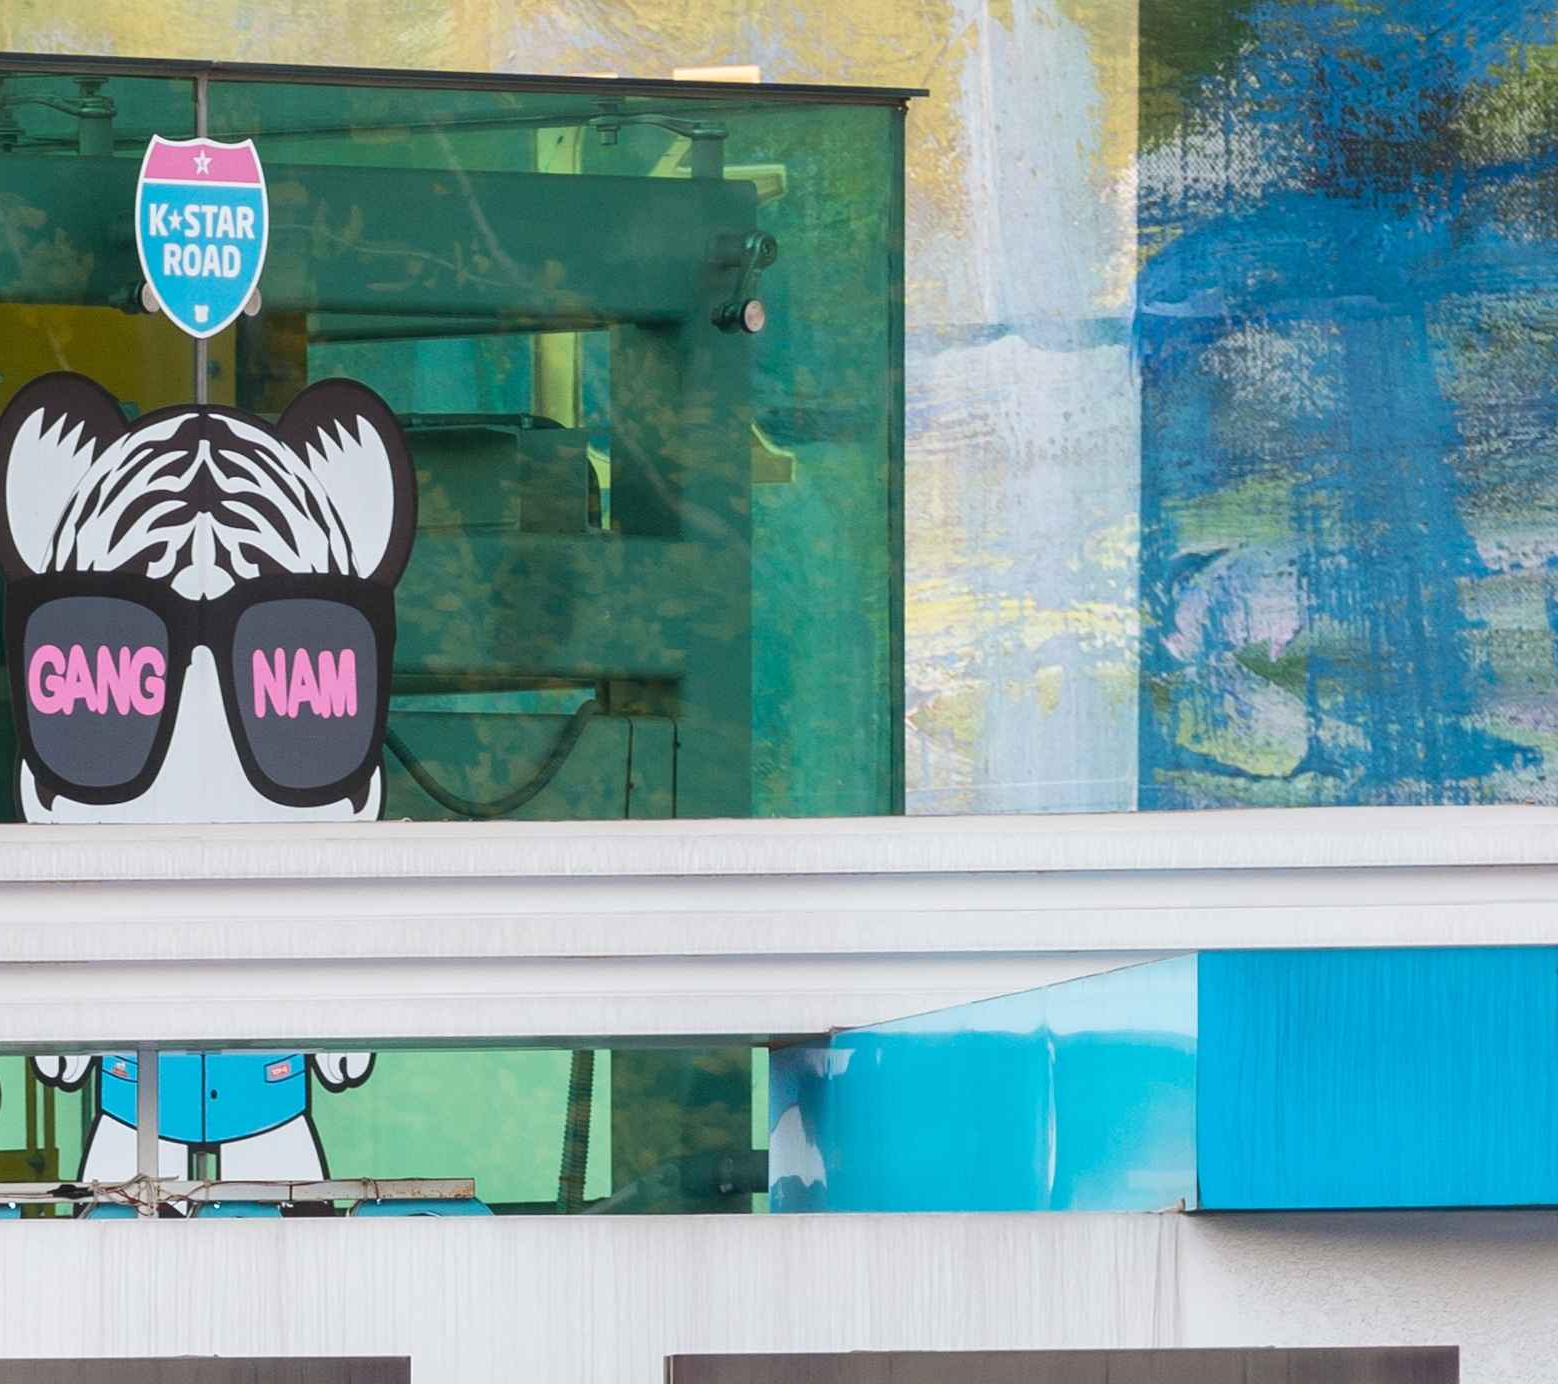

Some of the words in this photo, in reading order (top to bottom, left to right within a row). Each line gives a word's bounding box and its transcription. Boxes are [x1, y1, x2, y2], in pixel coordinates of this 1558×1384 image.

[163, 243, 242, 279] ROAD
[28, 644, 167, 716] GANG
[252, 647, 358, 718] NAM
